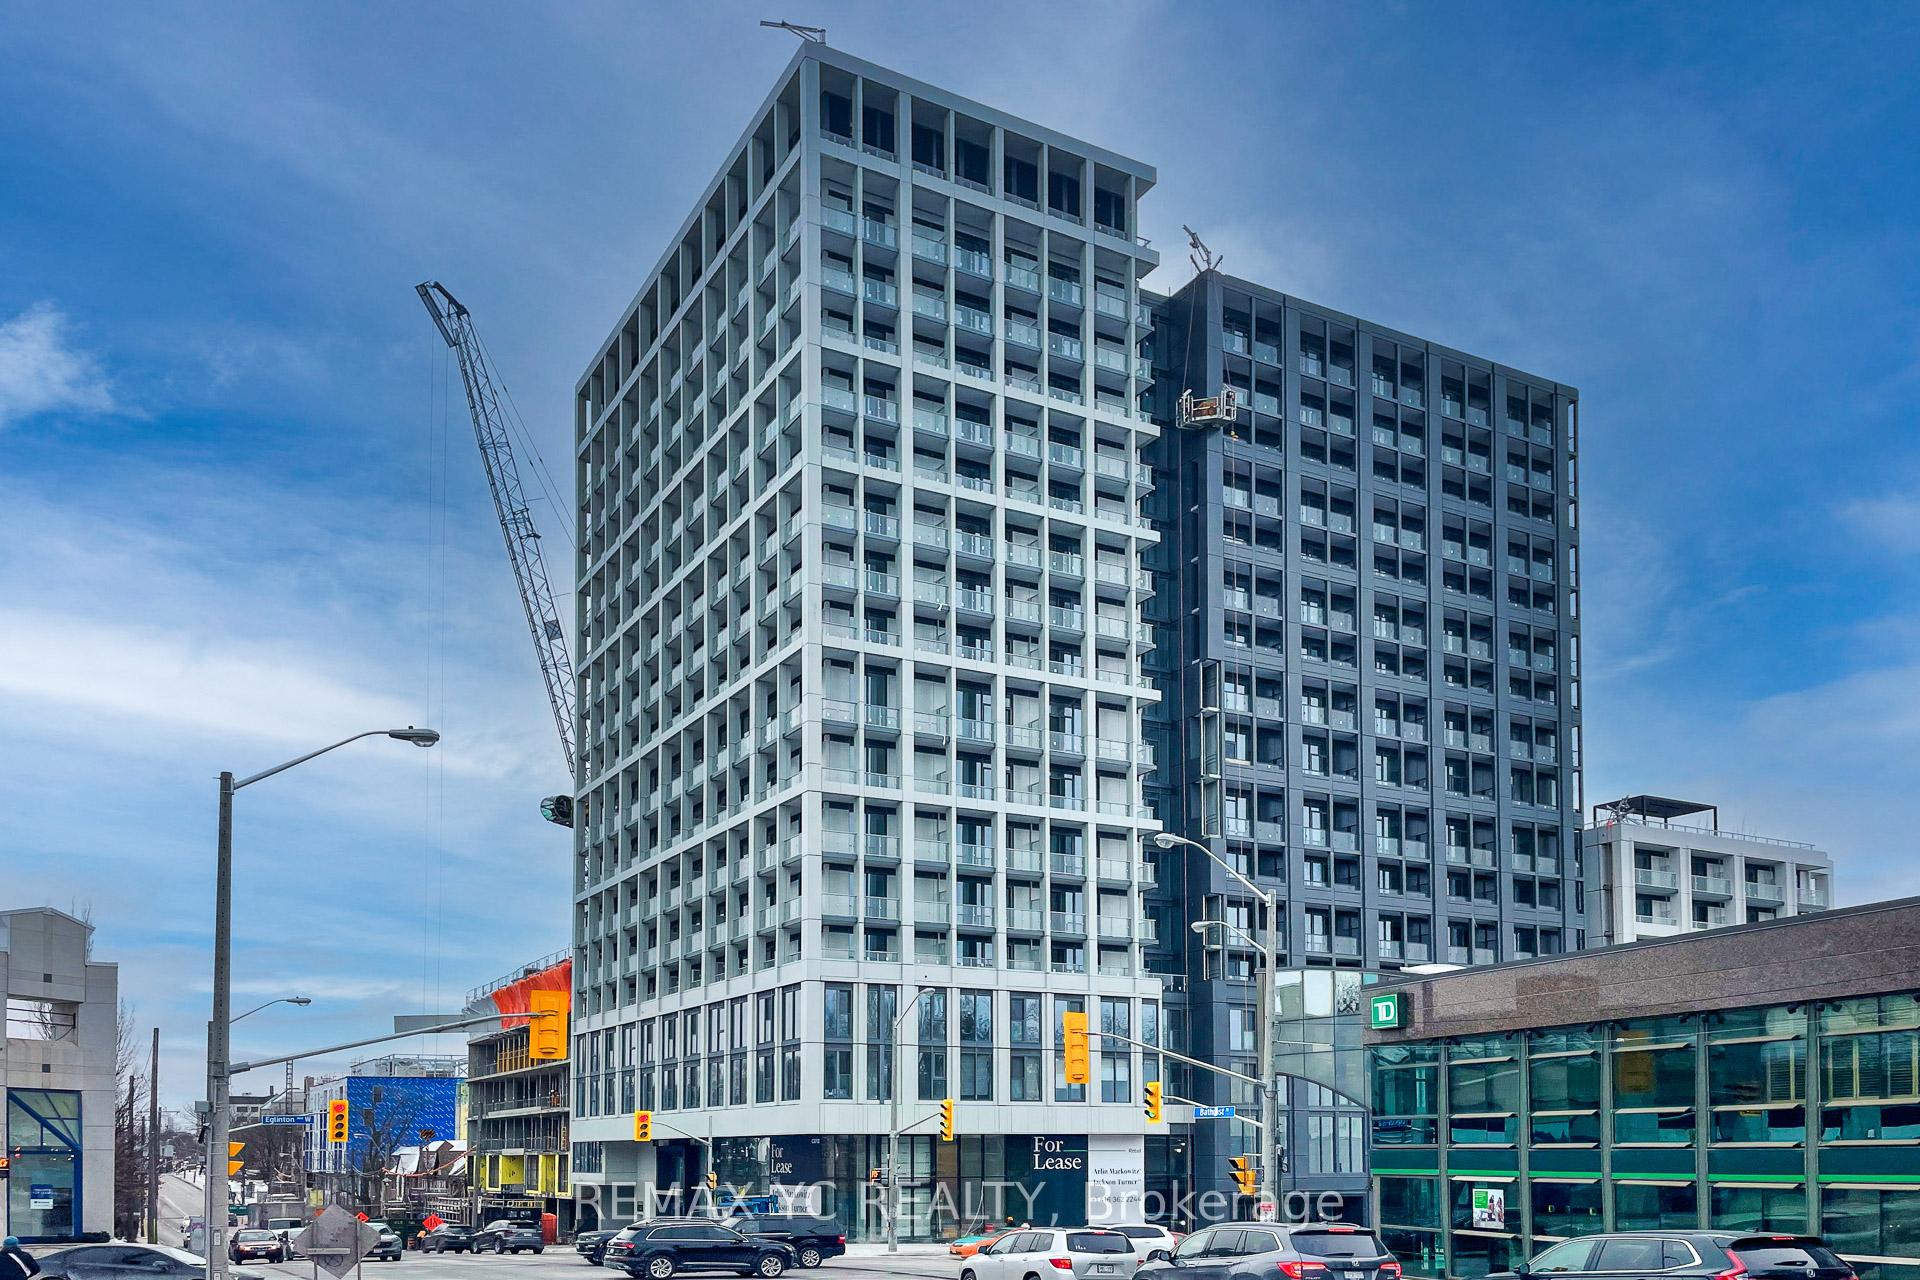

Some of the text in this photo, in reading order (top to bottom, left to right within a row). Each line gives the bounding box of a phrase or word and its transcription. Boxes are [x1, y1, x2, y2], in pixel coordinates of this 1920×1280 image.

[1374, 1001, 1395, 1021] TD
[1200, 1107, 1225, 1116] Bathst
[265, 1116, 295, 1124] Eglinton
[771, 1143, 784, 1158] For
[1033, 1136, 1064, 1152] For
[771, 1159, 793, 1174] Lease
[1033, 1153, 1082, 1170] Lease
